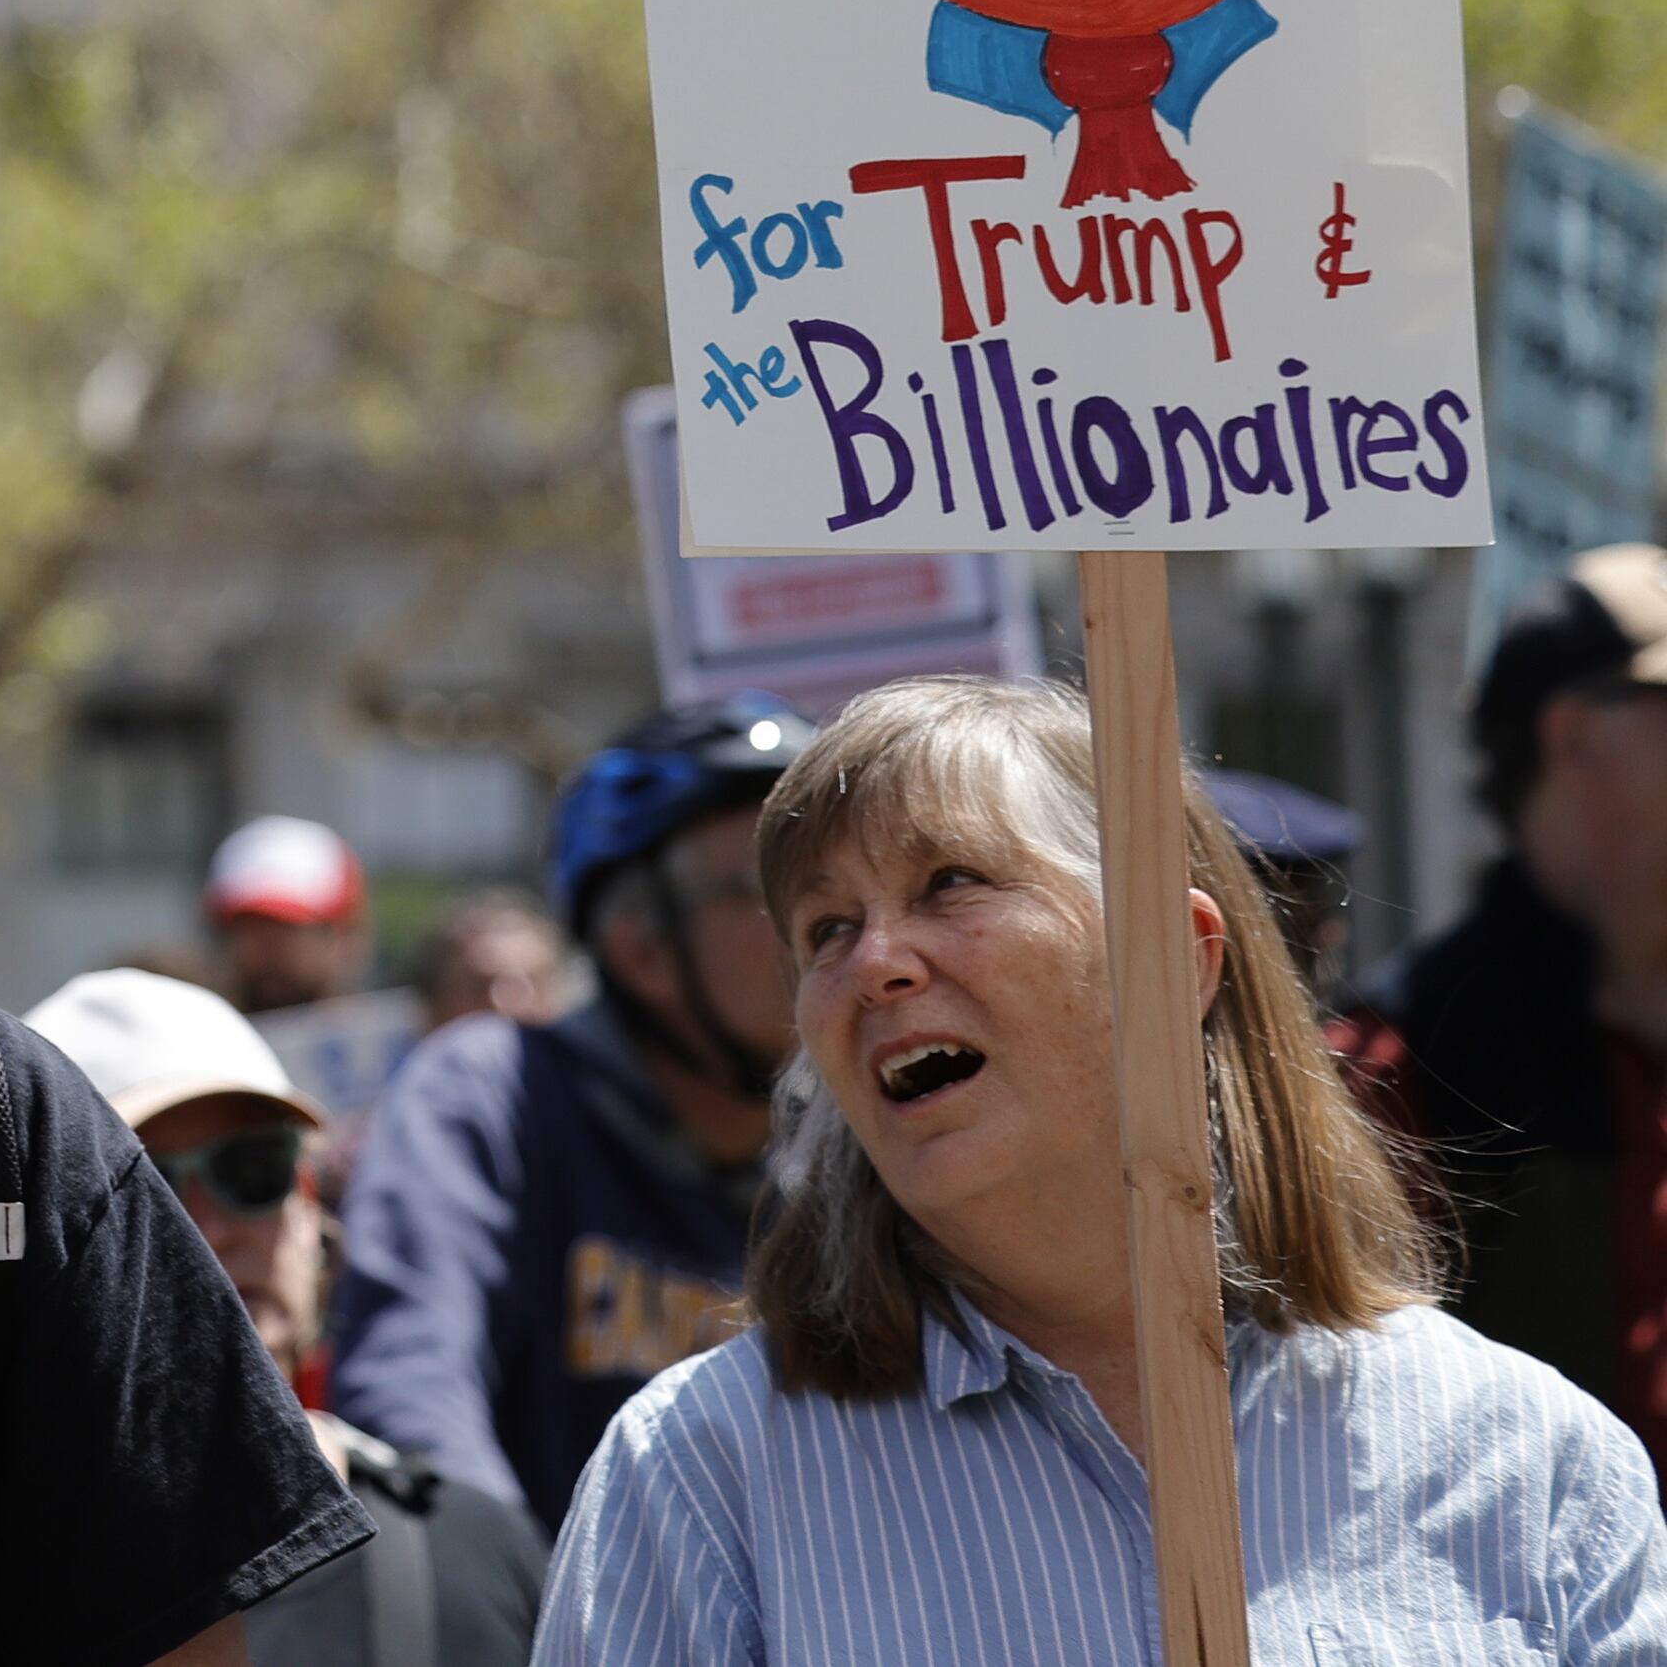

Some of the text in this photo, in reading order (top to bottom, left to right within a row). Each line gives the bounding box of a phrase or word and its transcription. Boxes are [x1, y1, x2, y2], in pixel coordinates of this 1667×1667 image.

[689, 172, 844, 314] for
[848, 154, 1244, 363] Trump
[700, 318, 1471, 533] the Billionaires
